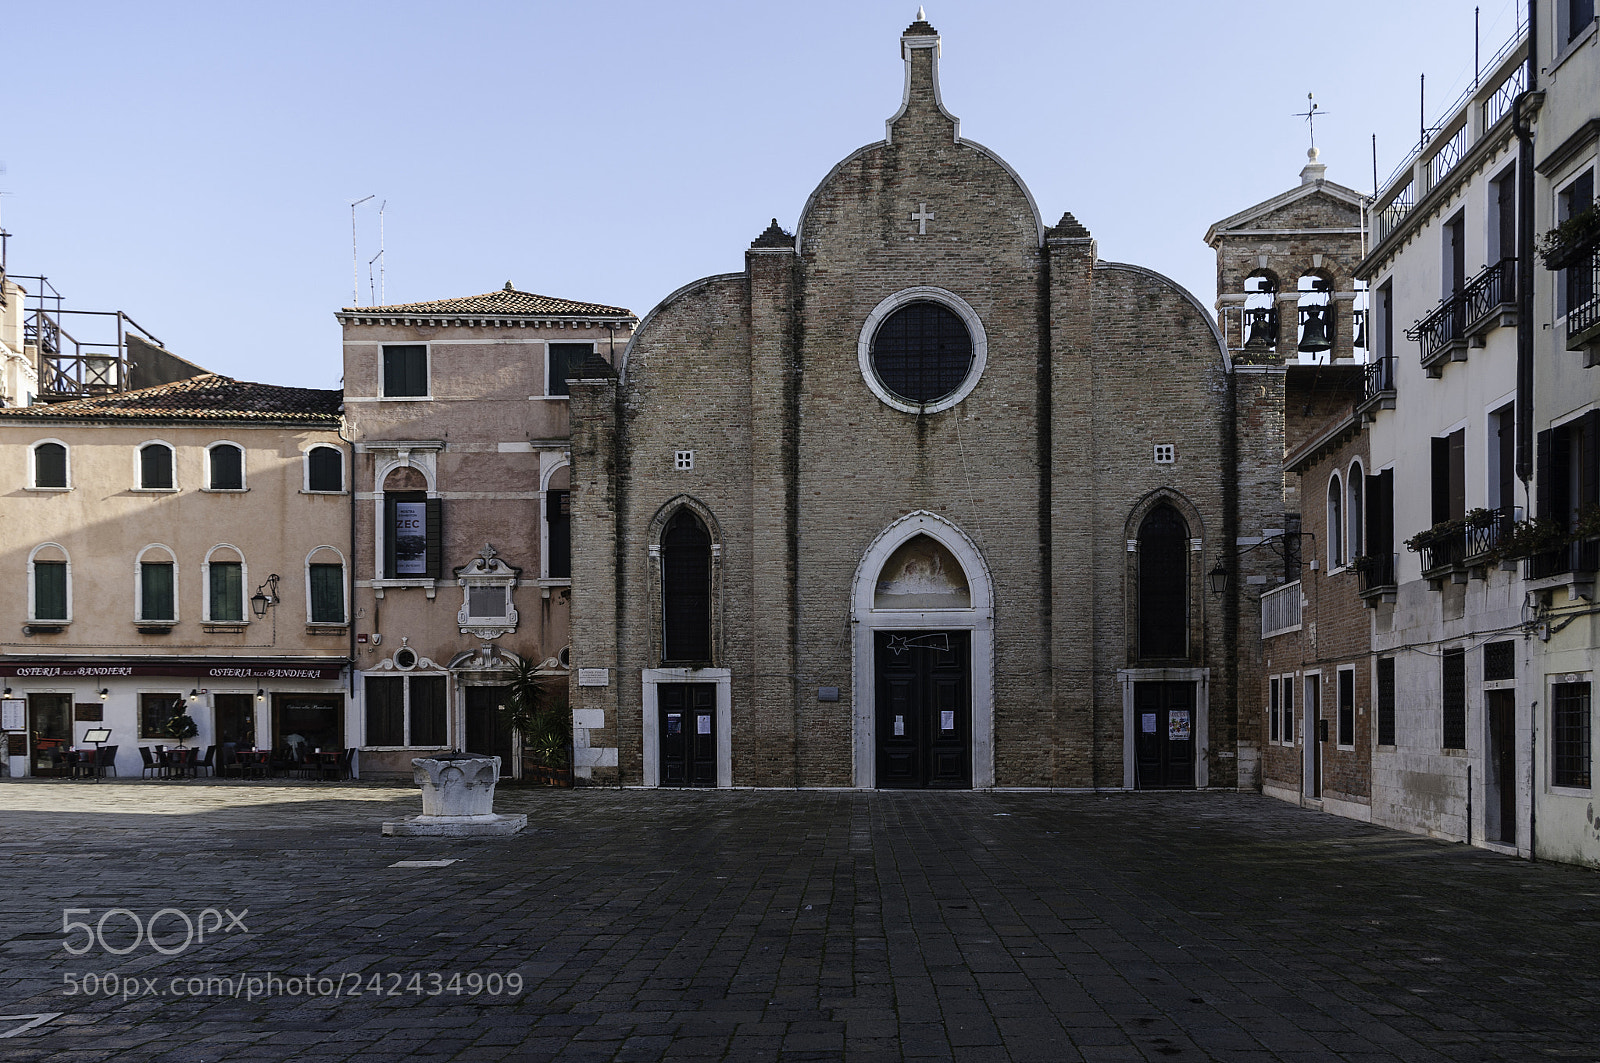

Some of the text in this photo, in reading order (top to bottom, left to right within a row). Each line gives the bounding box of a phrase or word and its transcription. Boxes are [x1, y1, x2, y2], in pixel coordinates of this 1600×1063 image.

[396, 519, 420, 529] ZEC
[17, 667, 60, 677] OSTERIA
[77, 667, 132, 676] BANDIERA
[209, 668, 251, 677] OSTERIA
[267, 668, 321, 679] BANDIERA
